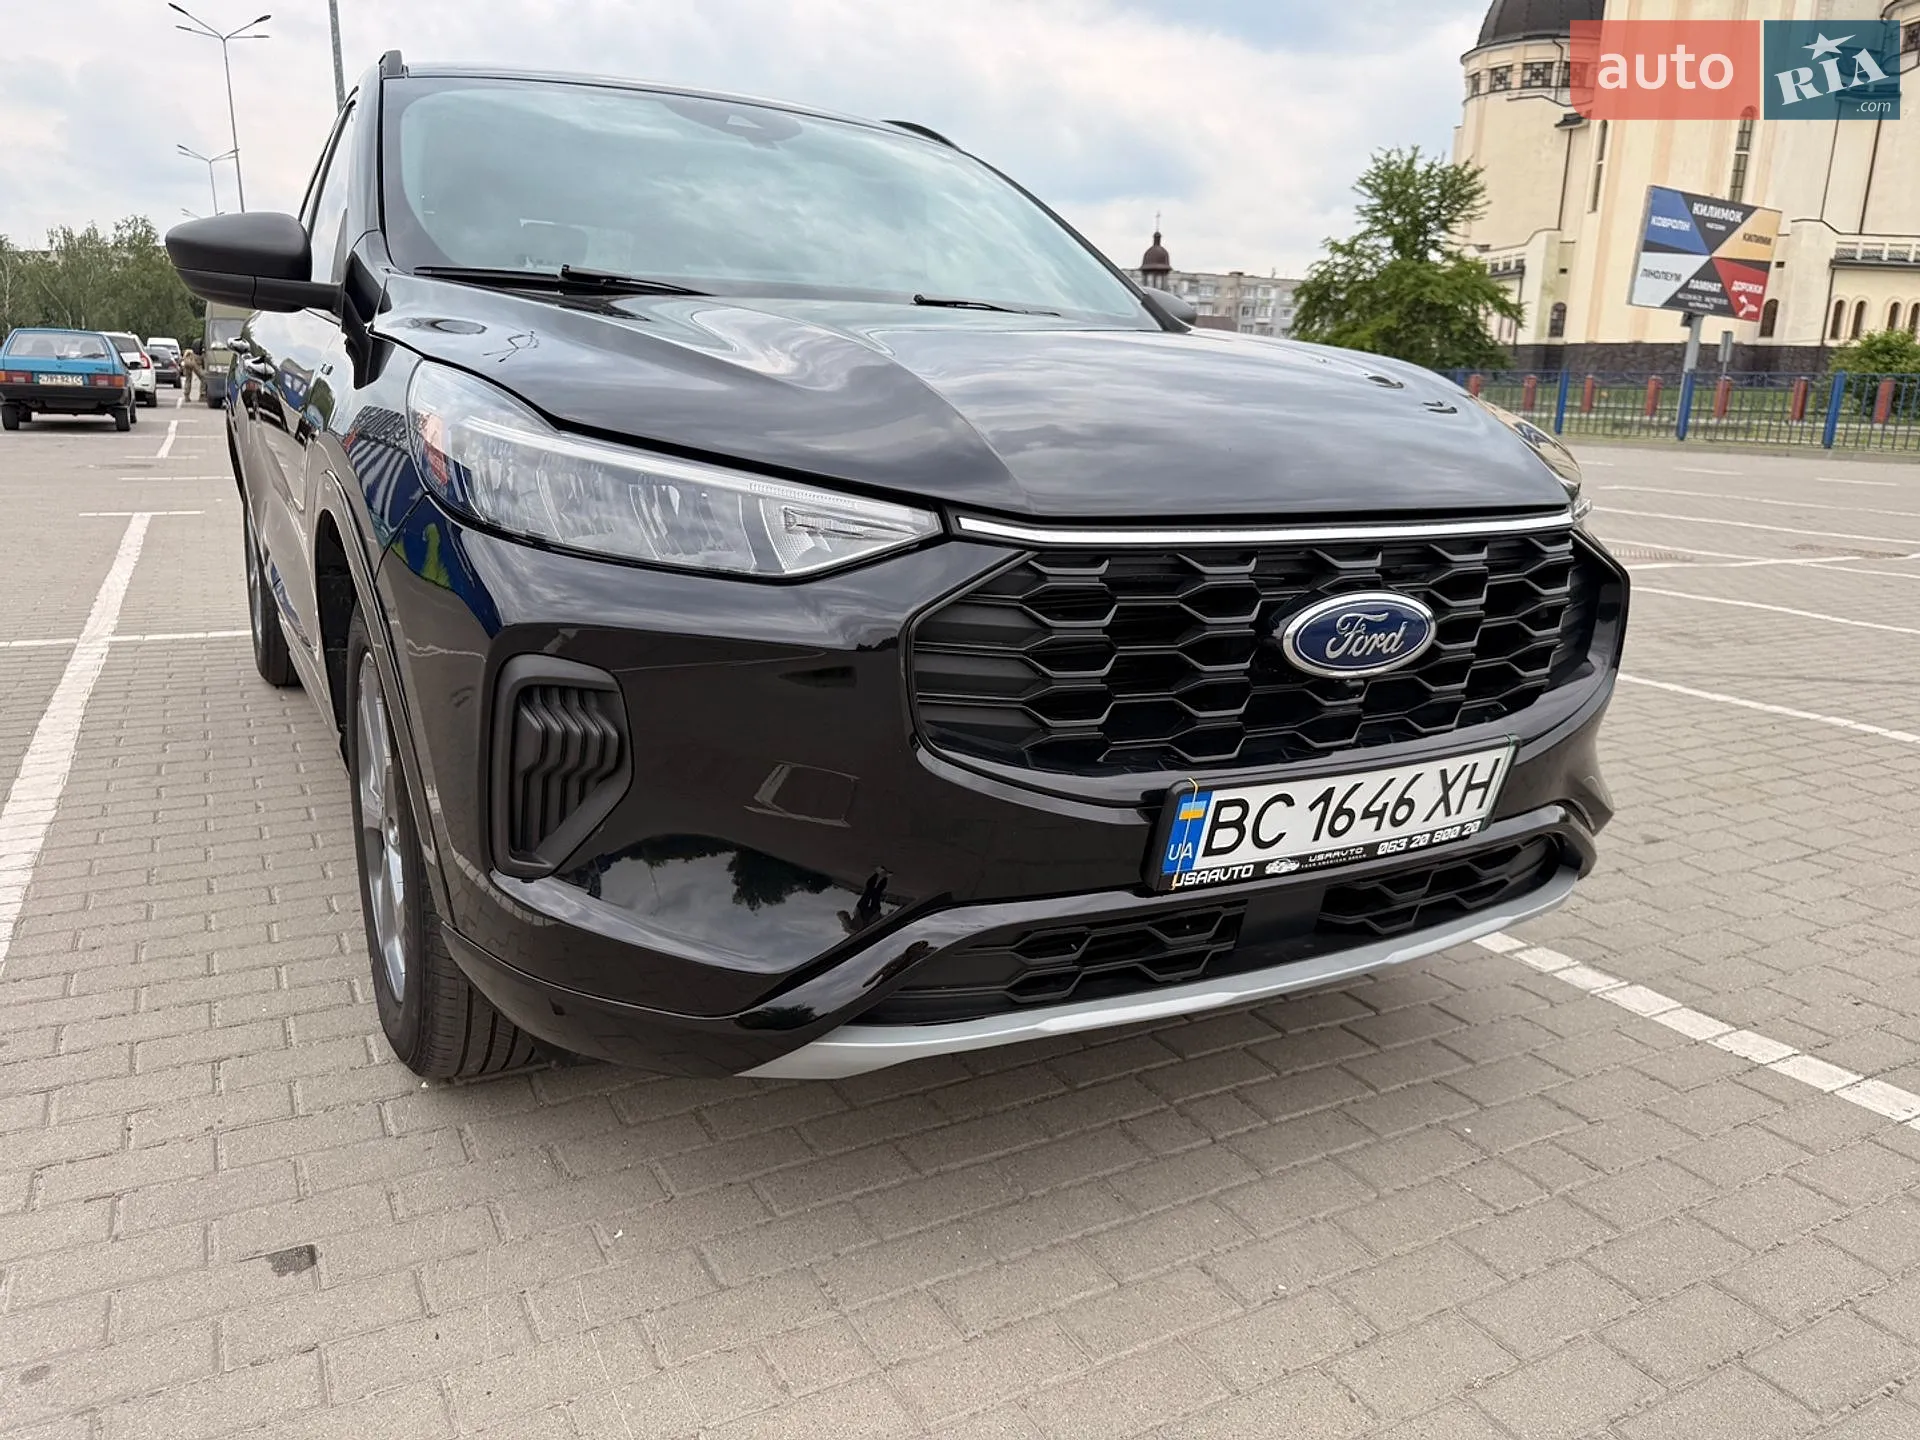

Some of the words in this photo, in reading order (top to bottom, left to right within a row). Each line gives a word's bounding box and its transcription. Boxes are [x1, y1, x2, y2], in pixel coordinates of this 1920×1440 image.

[1692, 202, 1744, 223] КИЛИМОК
[1325, 612, 1408, 659] Ford
[1202, 793, 1295, 857] BC
[1308, 772, 1424, 842] 1646
[1423, 758, 1501, 822] XH
[1168, 843, 1193, 861] UA
[1377, 838, 1408, 855] 063
[1174, 864, 1254, 887] USAAUTO
